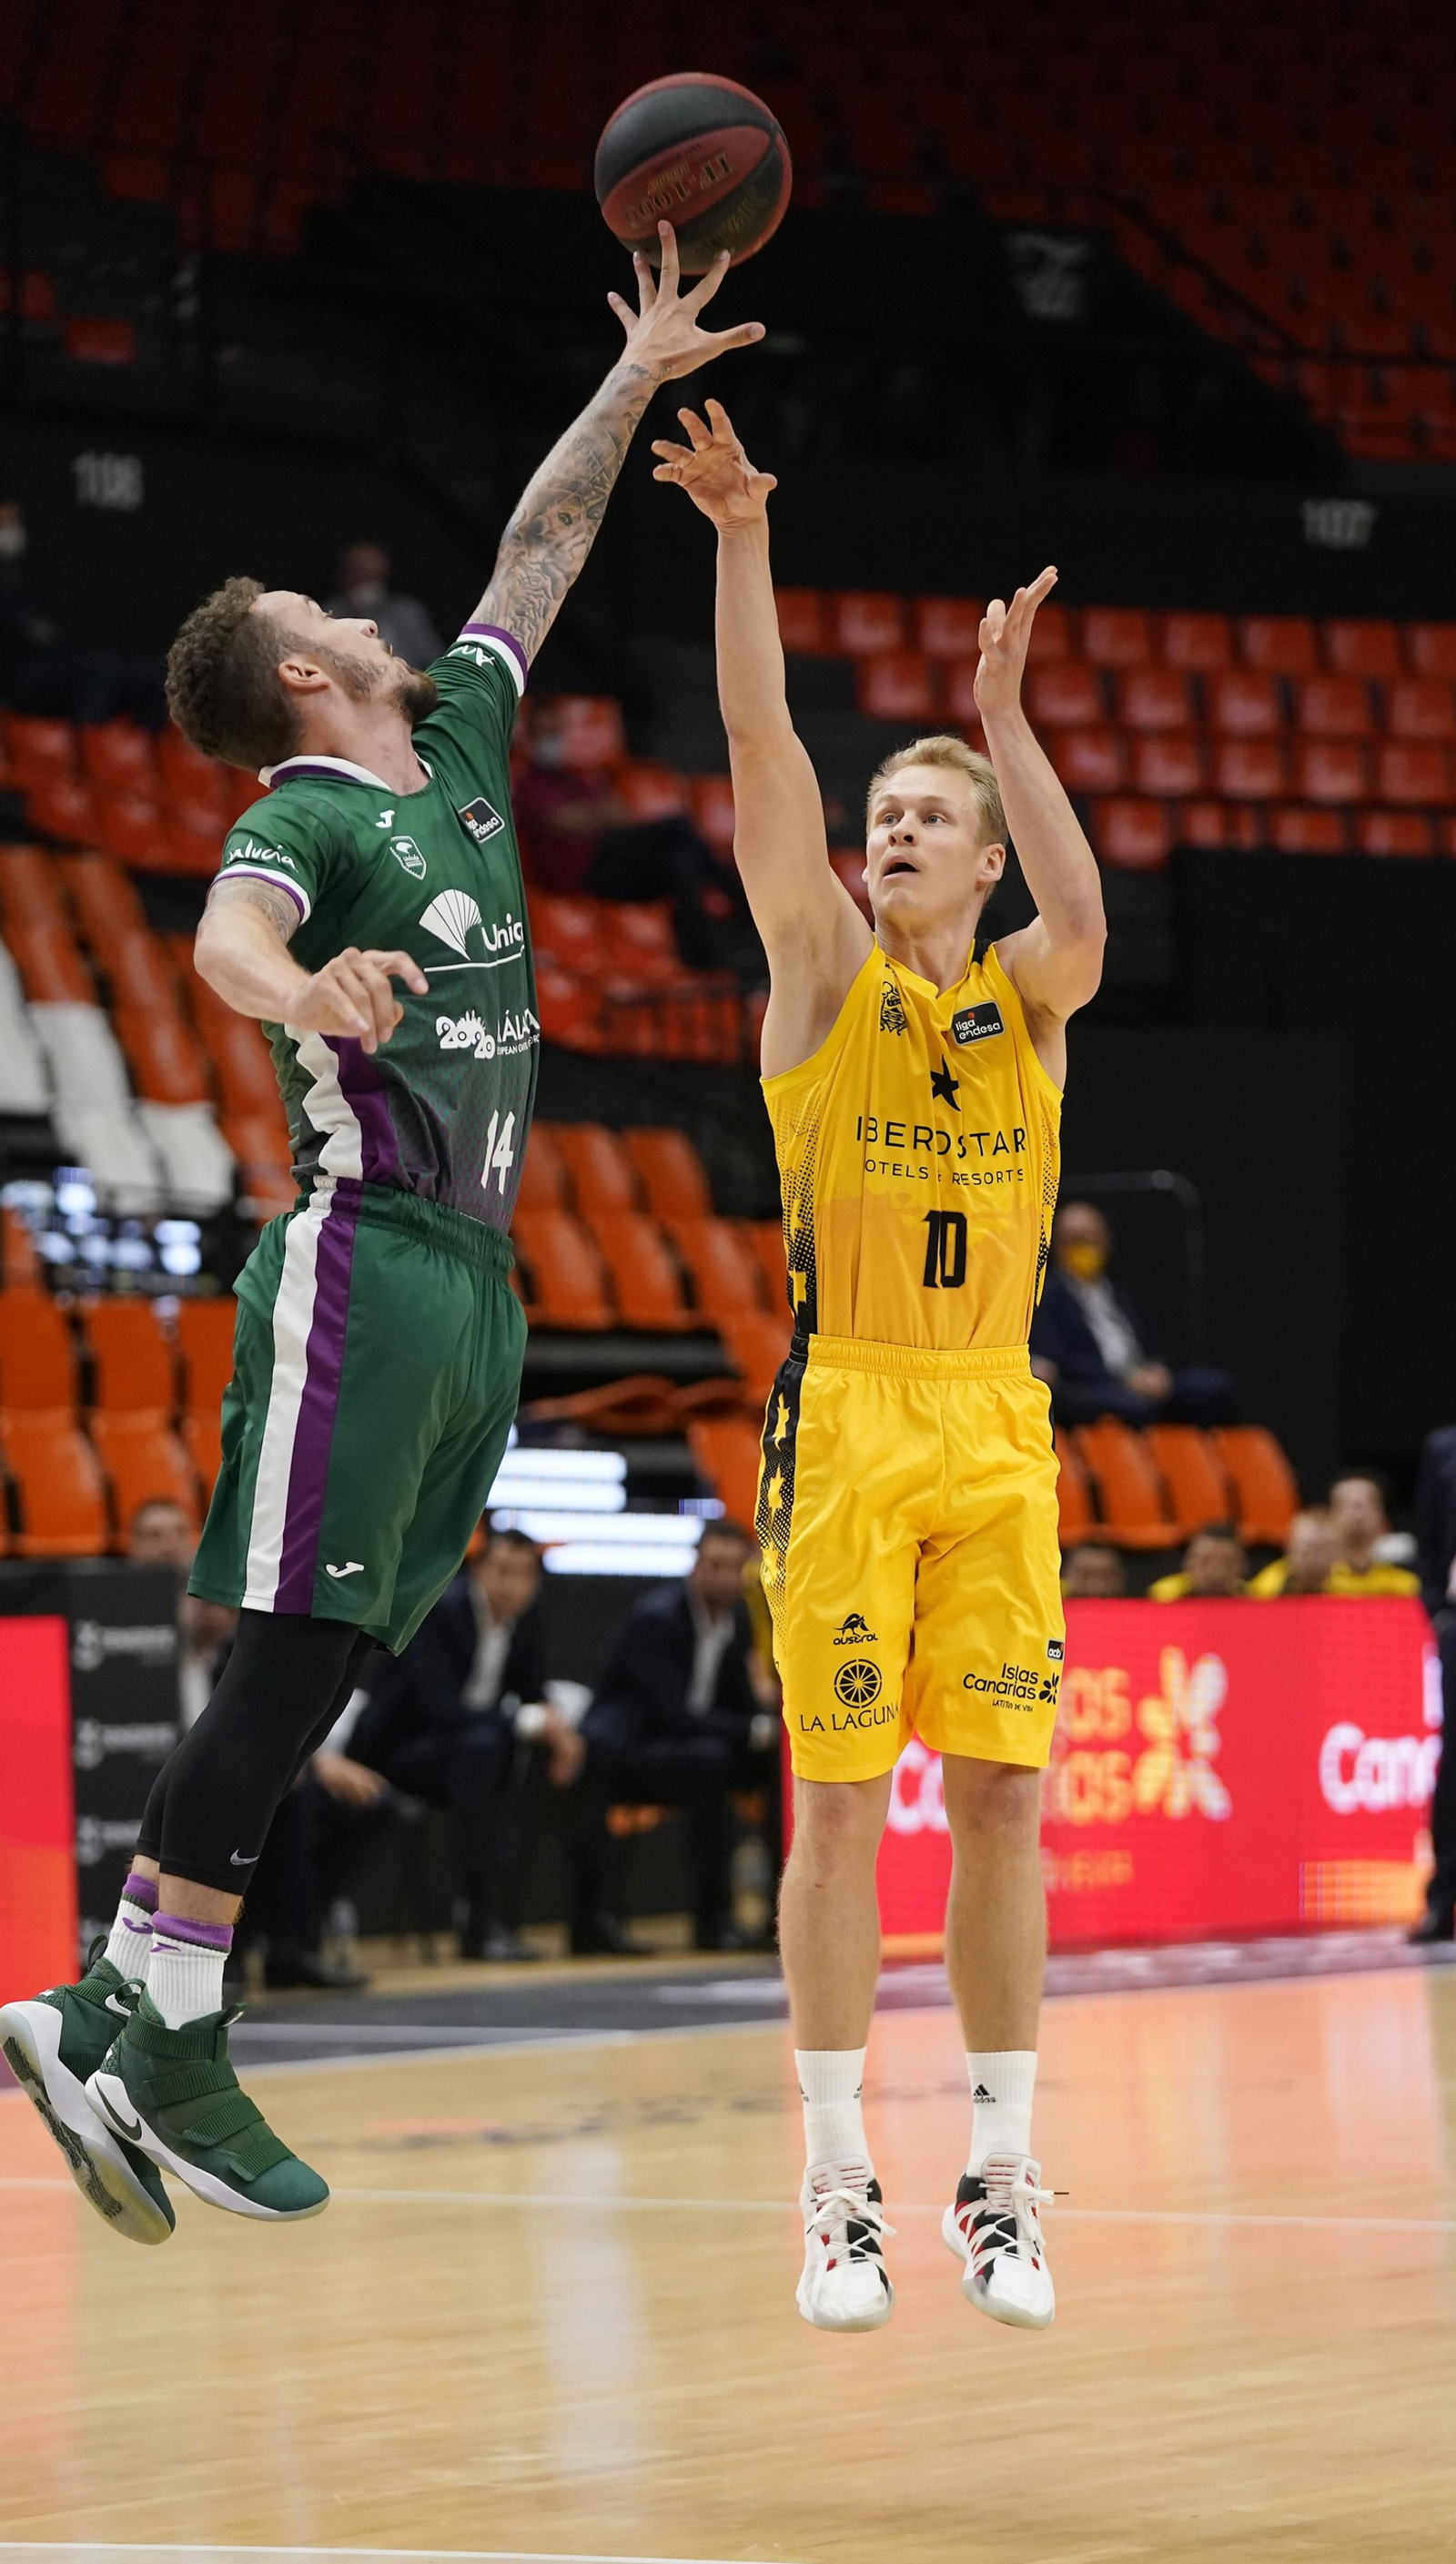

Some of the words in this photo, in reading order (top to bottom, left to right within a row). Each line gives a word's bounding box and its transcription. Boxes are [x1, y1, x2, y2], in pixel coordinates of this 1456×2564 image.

[956, 1019, 976, 1031] liga
[958, 1022, 1001, 1039] endesa
[856, 1116, 1026, 1159] IBEROSTAR
[480, 1109, 515, 1195] 14
[864, 1159, 929, 1180] OTELS
[952, 1169, 1024, 1186] RESORTS
[921, 1210, 967, 1289] 10
[833, 1634, 878, 1646] austral
[1048, 1647, 1062, 1658] acb
[1001, 1663, 1038, 1685] Islas
[963, 1673, 1036, 1700] Canarias
[800, 1715, 825, 1731] LA
